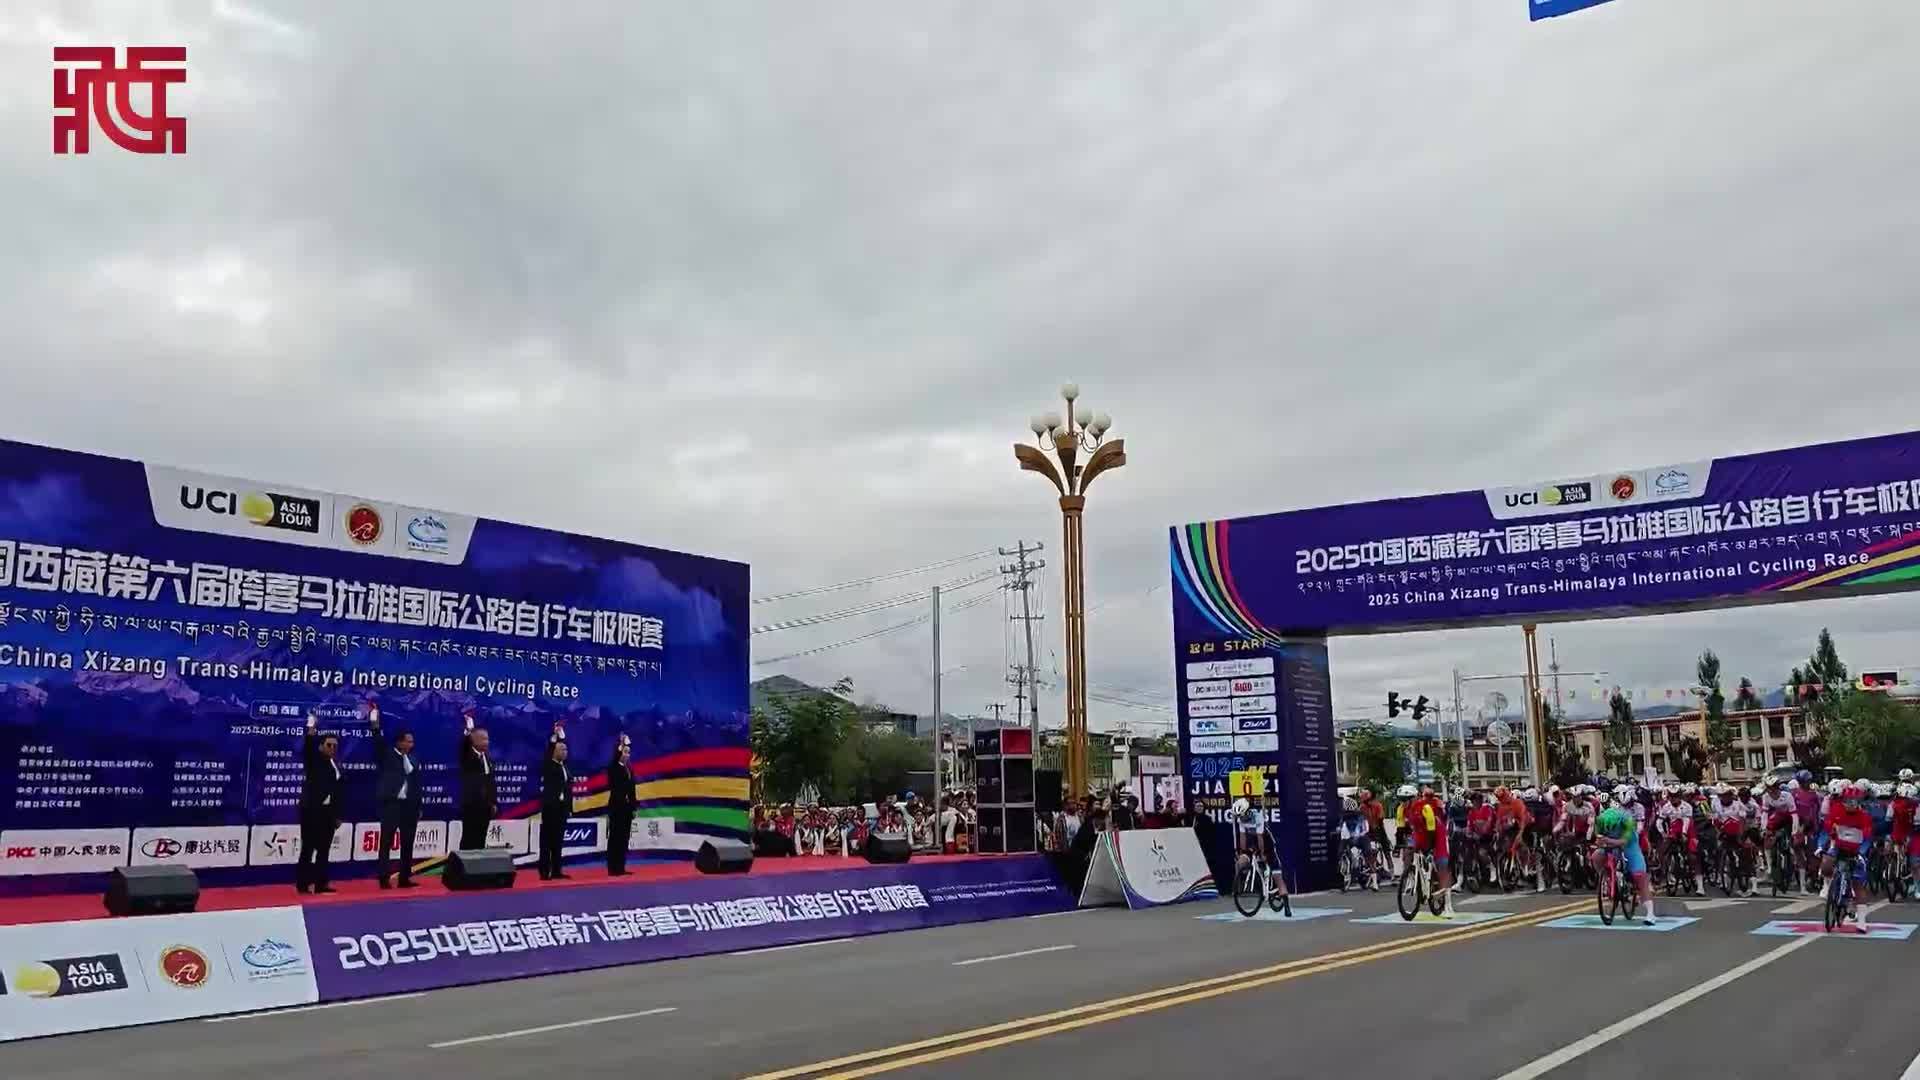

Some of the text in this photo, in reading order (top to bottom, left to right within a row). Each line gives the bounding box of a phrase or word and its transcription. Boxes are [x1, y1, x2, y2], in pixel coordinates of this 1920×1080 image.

[1564, 487, 1583, 495] ASIA
[1565, 493, 1587, 502] TOUR
[180, 485, 237, 515] UCI
[1505, 492, 1538, 507] UCI
[280, 501, 309, 515] ASIA
[279, 513, 312, 527] TOUR
[1296, 480, 1920, 574] 2025中国西藏第六届跨喜马拉雅国际公路自行车极
[1368, 551, 1870, 606] 2025 China Xizang Trans-Himalaya International Cycling Race
[1223, 638, 1267, 652] START
[0, 644, 579, 698] China Xizang Trans-Himalaya International Cycling Race
[7, 846, 36, 858] PICC
[332, 884, 930, 969] 2025中国西藏第六届跨喜马拉雅国际公路自行车极限赛
[66, 961, 107, 977] ASIA
[67, 972, 117, 988] TOUR
